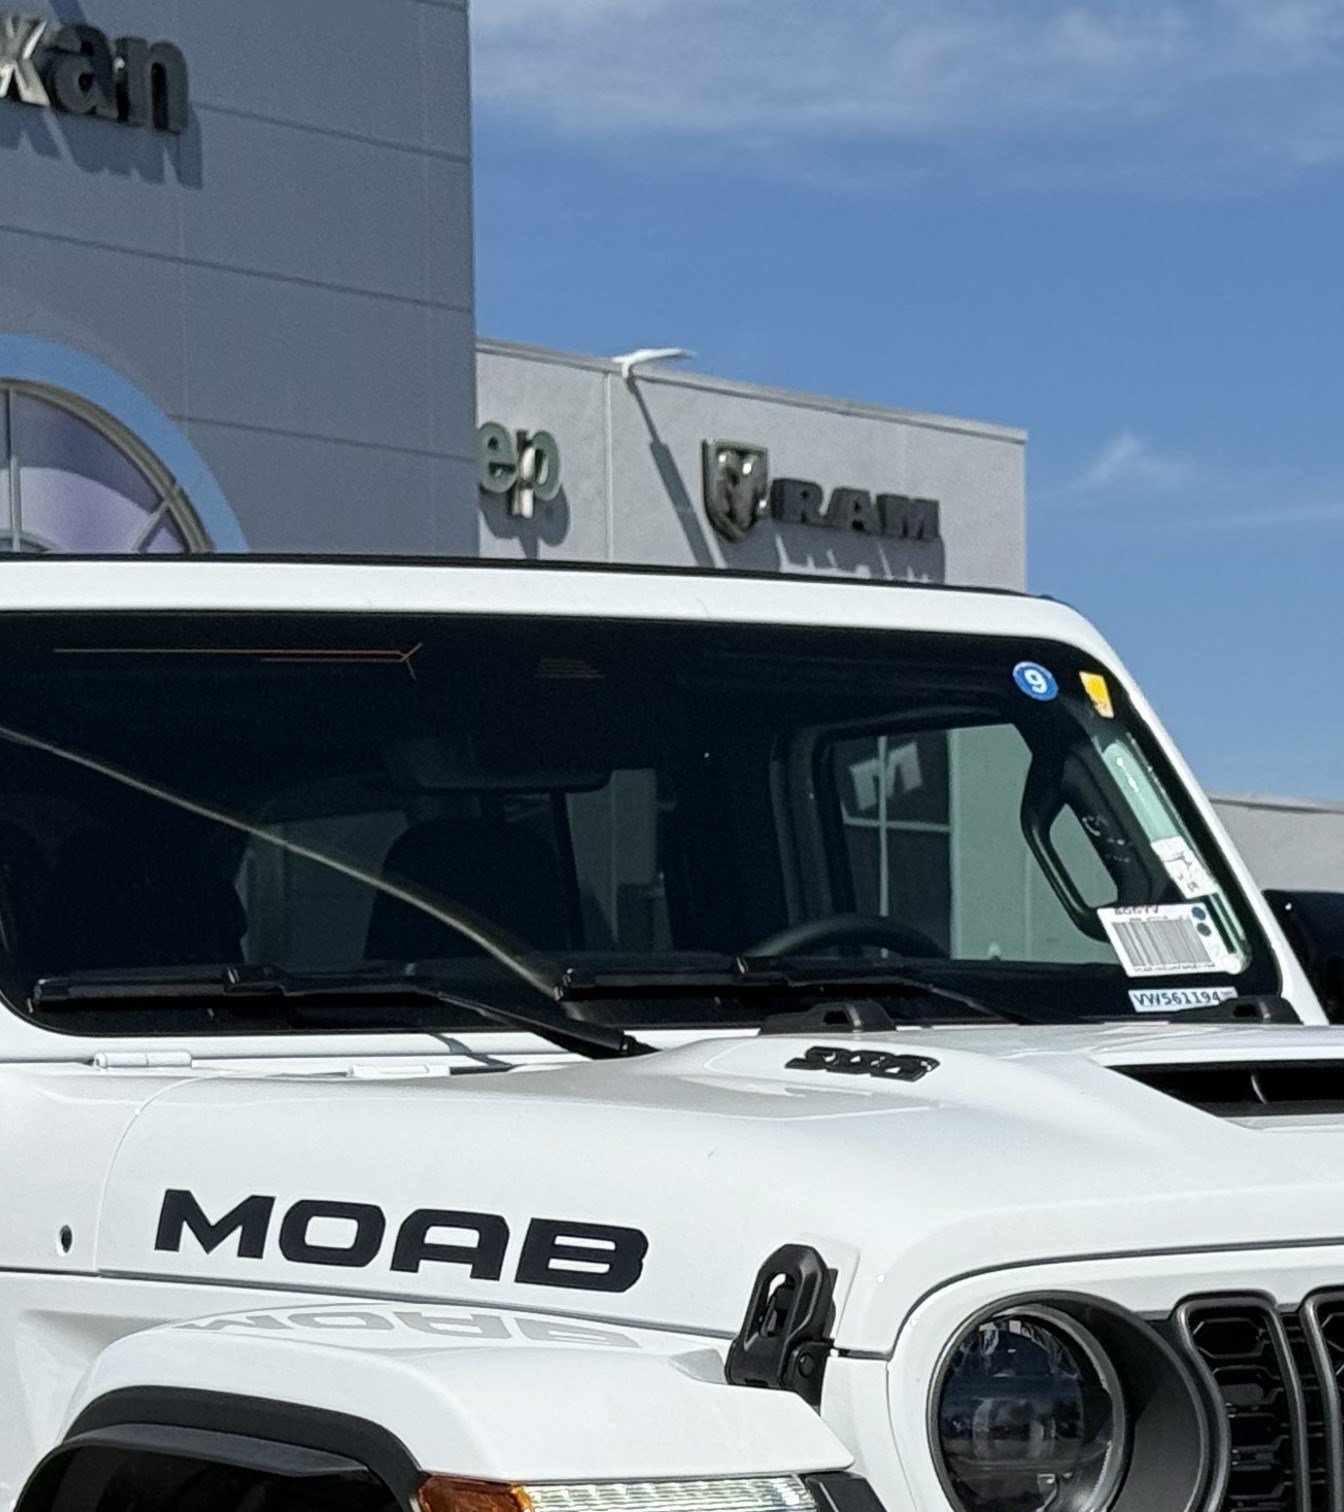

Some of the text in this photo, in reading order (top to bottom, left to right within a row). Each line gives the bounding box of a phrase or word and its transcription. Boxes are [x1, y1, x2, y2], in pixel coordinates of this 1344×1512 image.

[477, 421, 561, 519] ep
[770, 477, 941, 541] RAM
[1023, 668, 1048, 695] 9
[153, 1188, 649, 1293] MOAB
